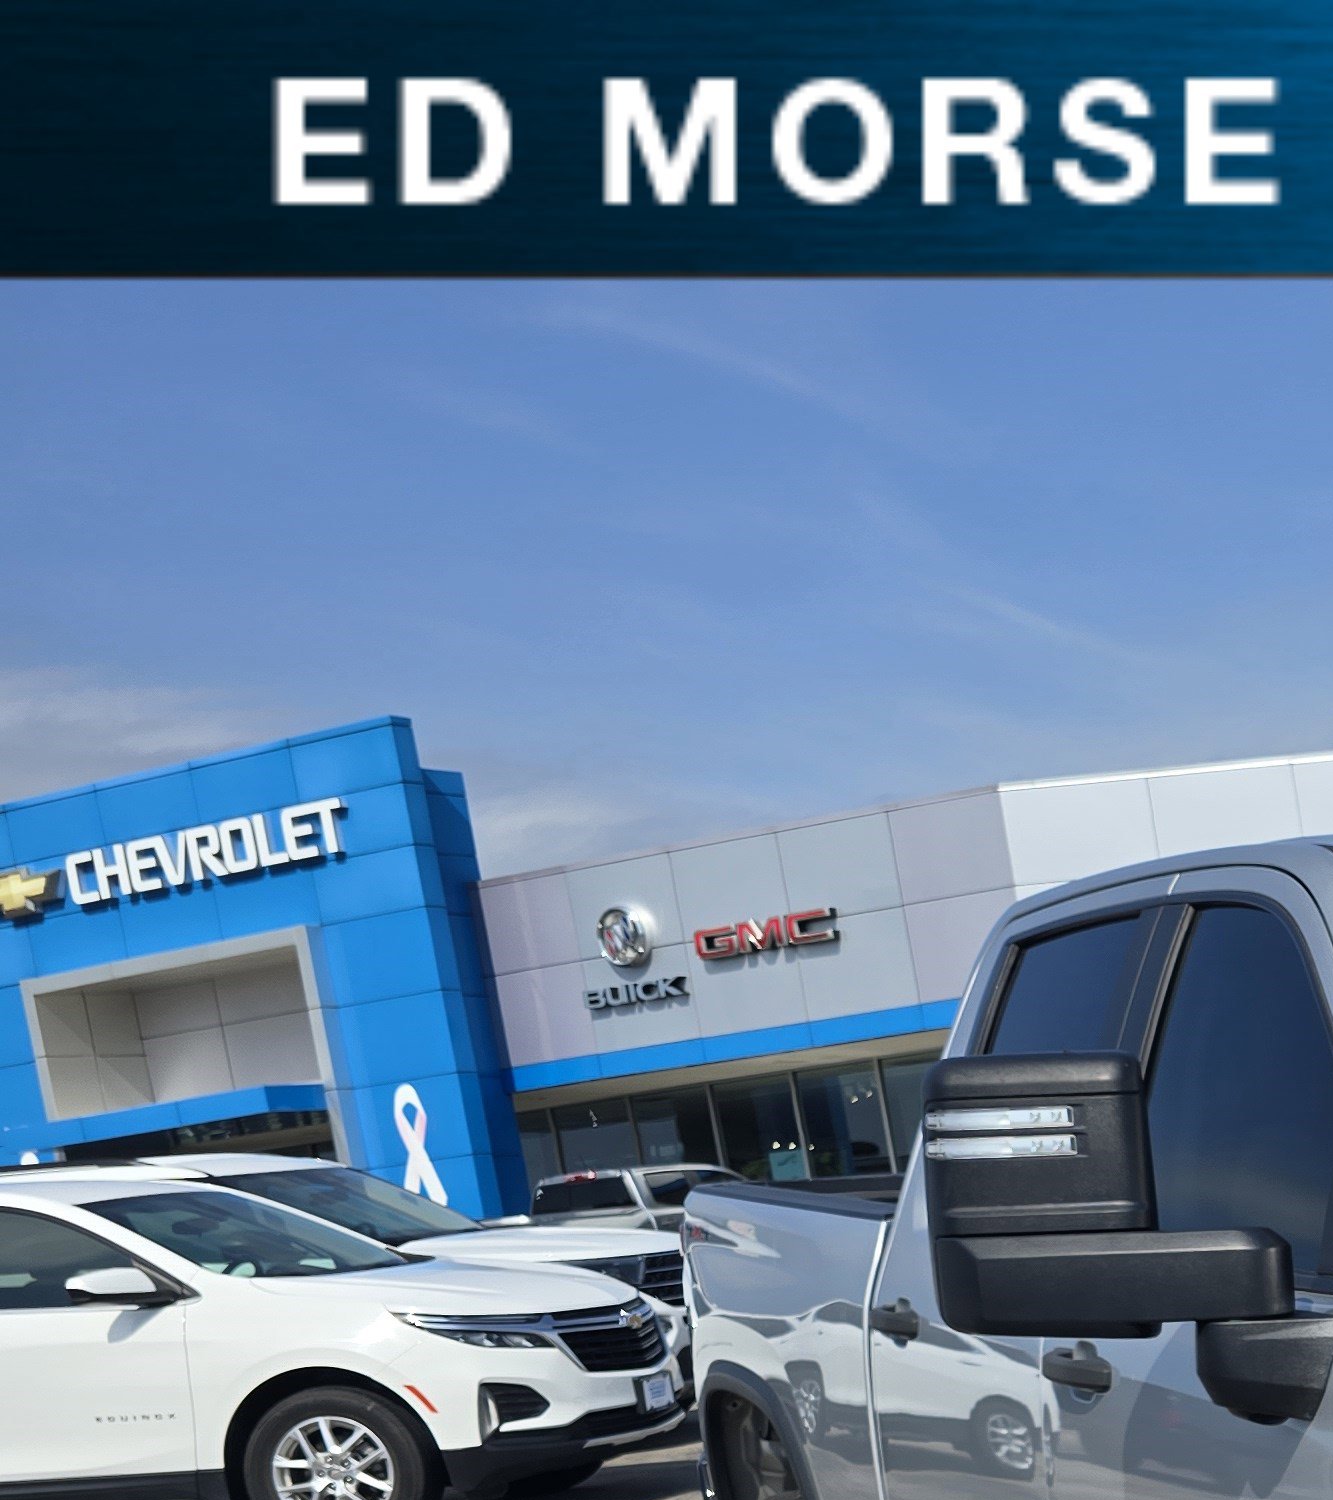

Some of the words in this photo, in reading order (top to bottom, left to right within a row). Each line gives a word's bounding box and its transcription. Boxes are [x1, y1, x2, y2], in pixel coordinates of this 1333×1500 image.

[65, 796, 342, 905] CHEVROLET
[693, 908, 837, 960] GMC
[584, 976, 690, 1010] BUICK
